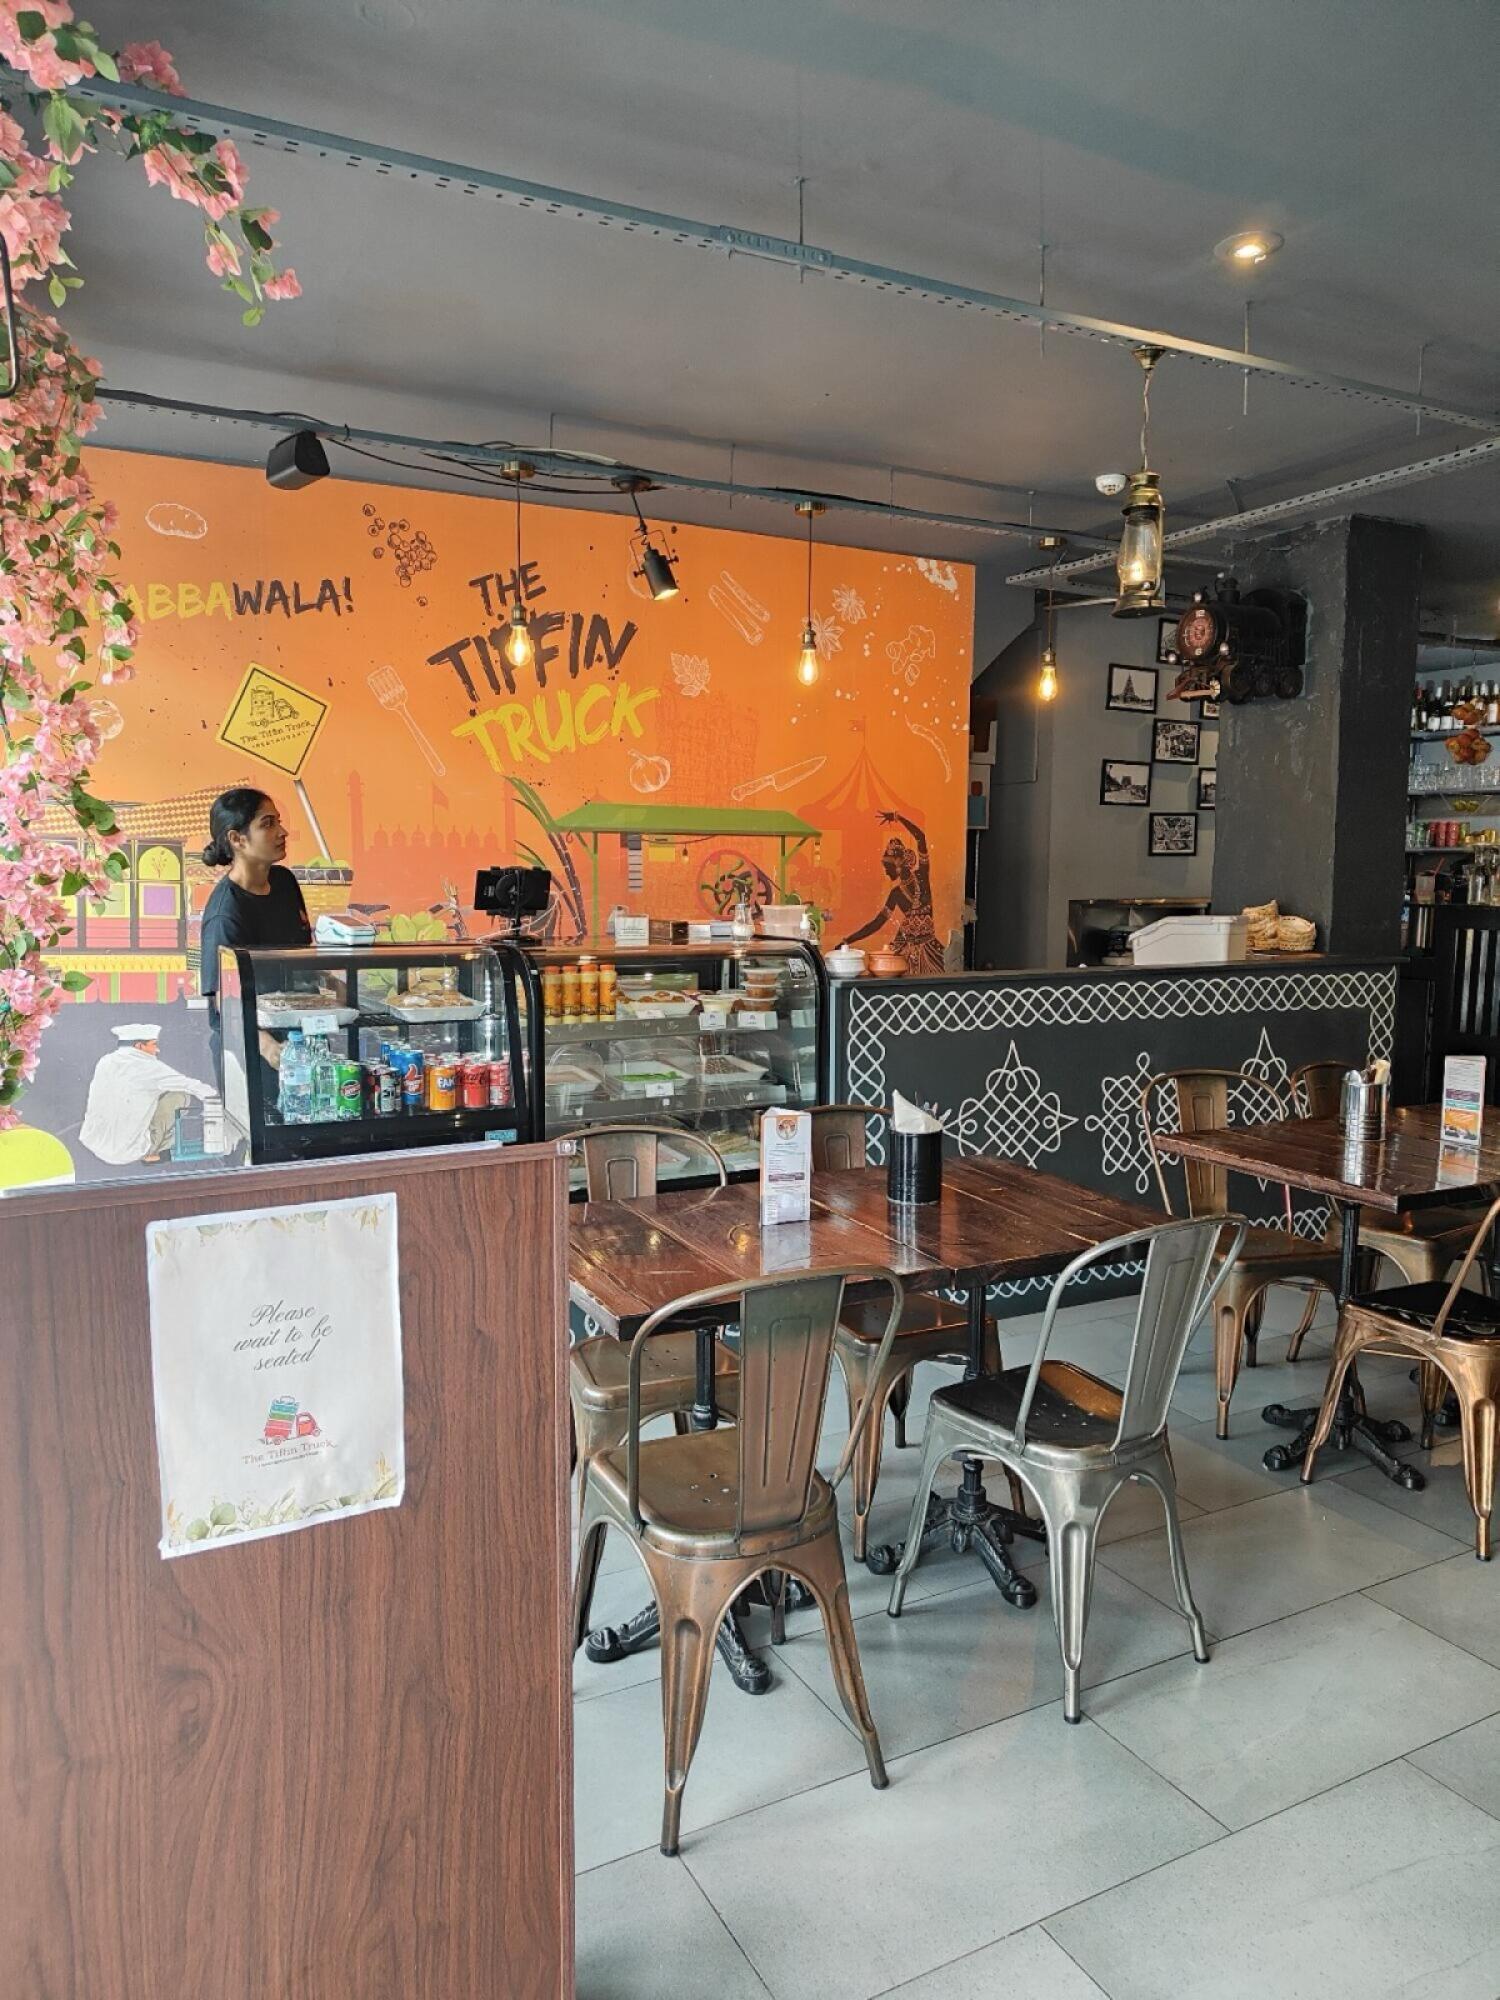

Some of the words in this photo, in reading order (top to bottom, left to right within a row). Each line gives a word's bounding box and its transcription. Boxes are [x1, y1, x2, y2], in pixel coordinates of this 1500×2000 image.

[468, 560, 547, 617] THE
[426, 608, 639, 703] TIFFIN
[451, 682, 662, 774] TRUCK
[249, 1299, 316, 1327] Please
[233, 1328, 281, 1352] wait
[284, 1325, 304, 1343] to
[311, 1314, 334, 1339] be
[253, 1338, 321, 1371] seated
[241, 1454, 264, 1464] The
[300, 1439, 338, 1451] Truck
